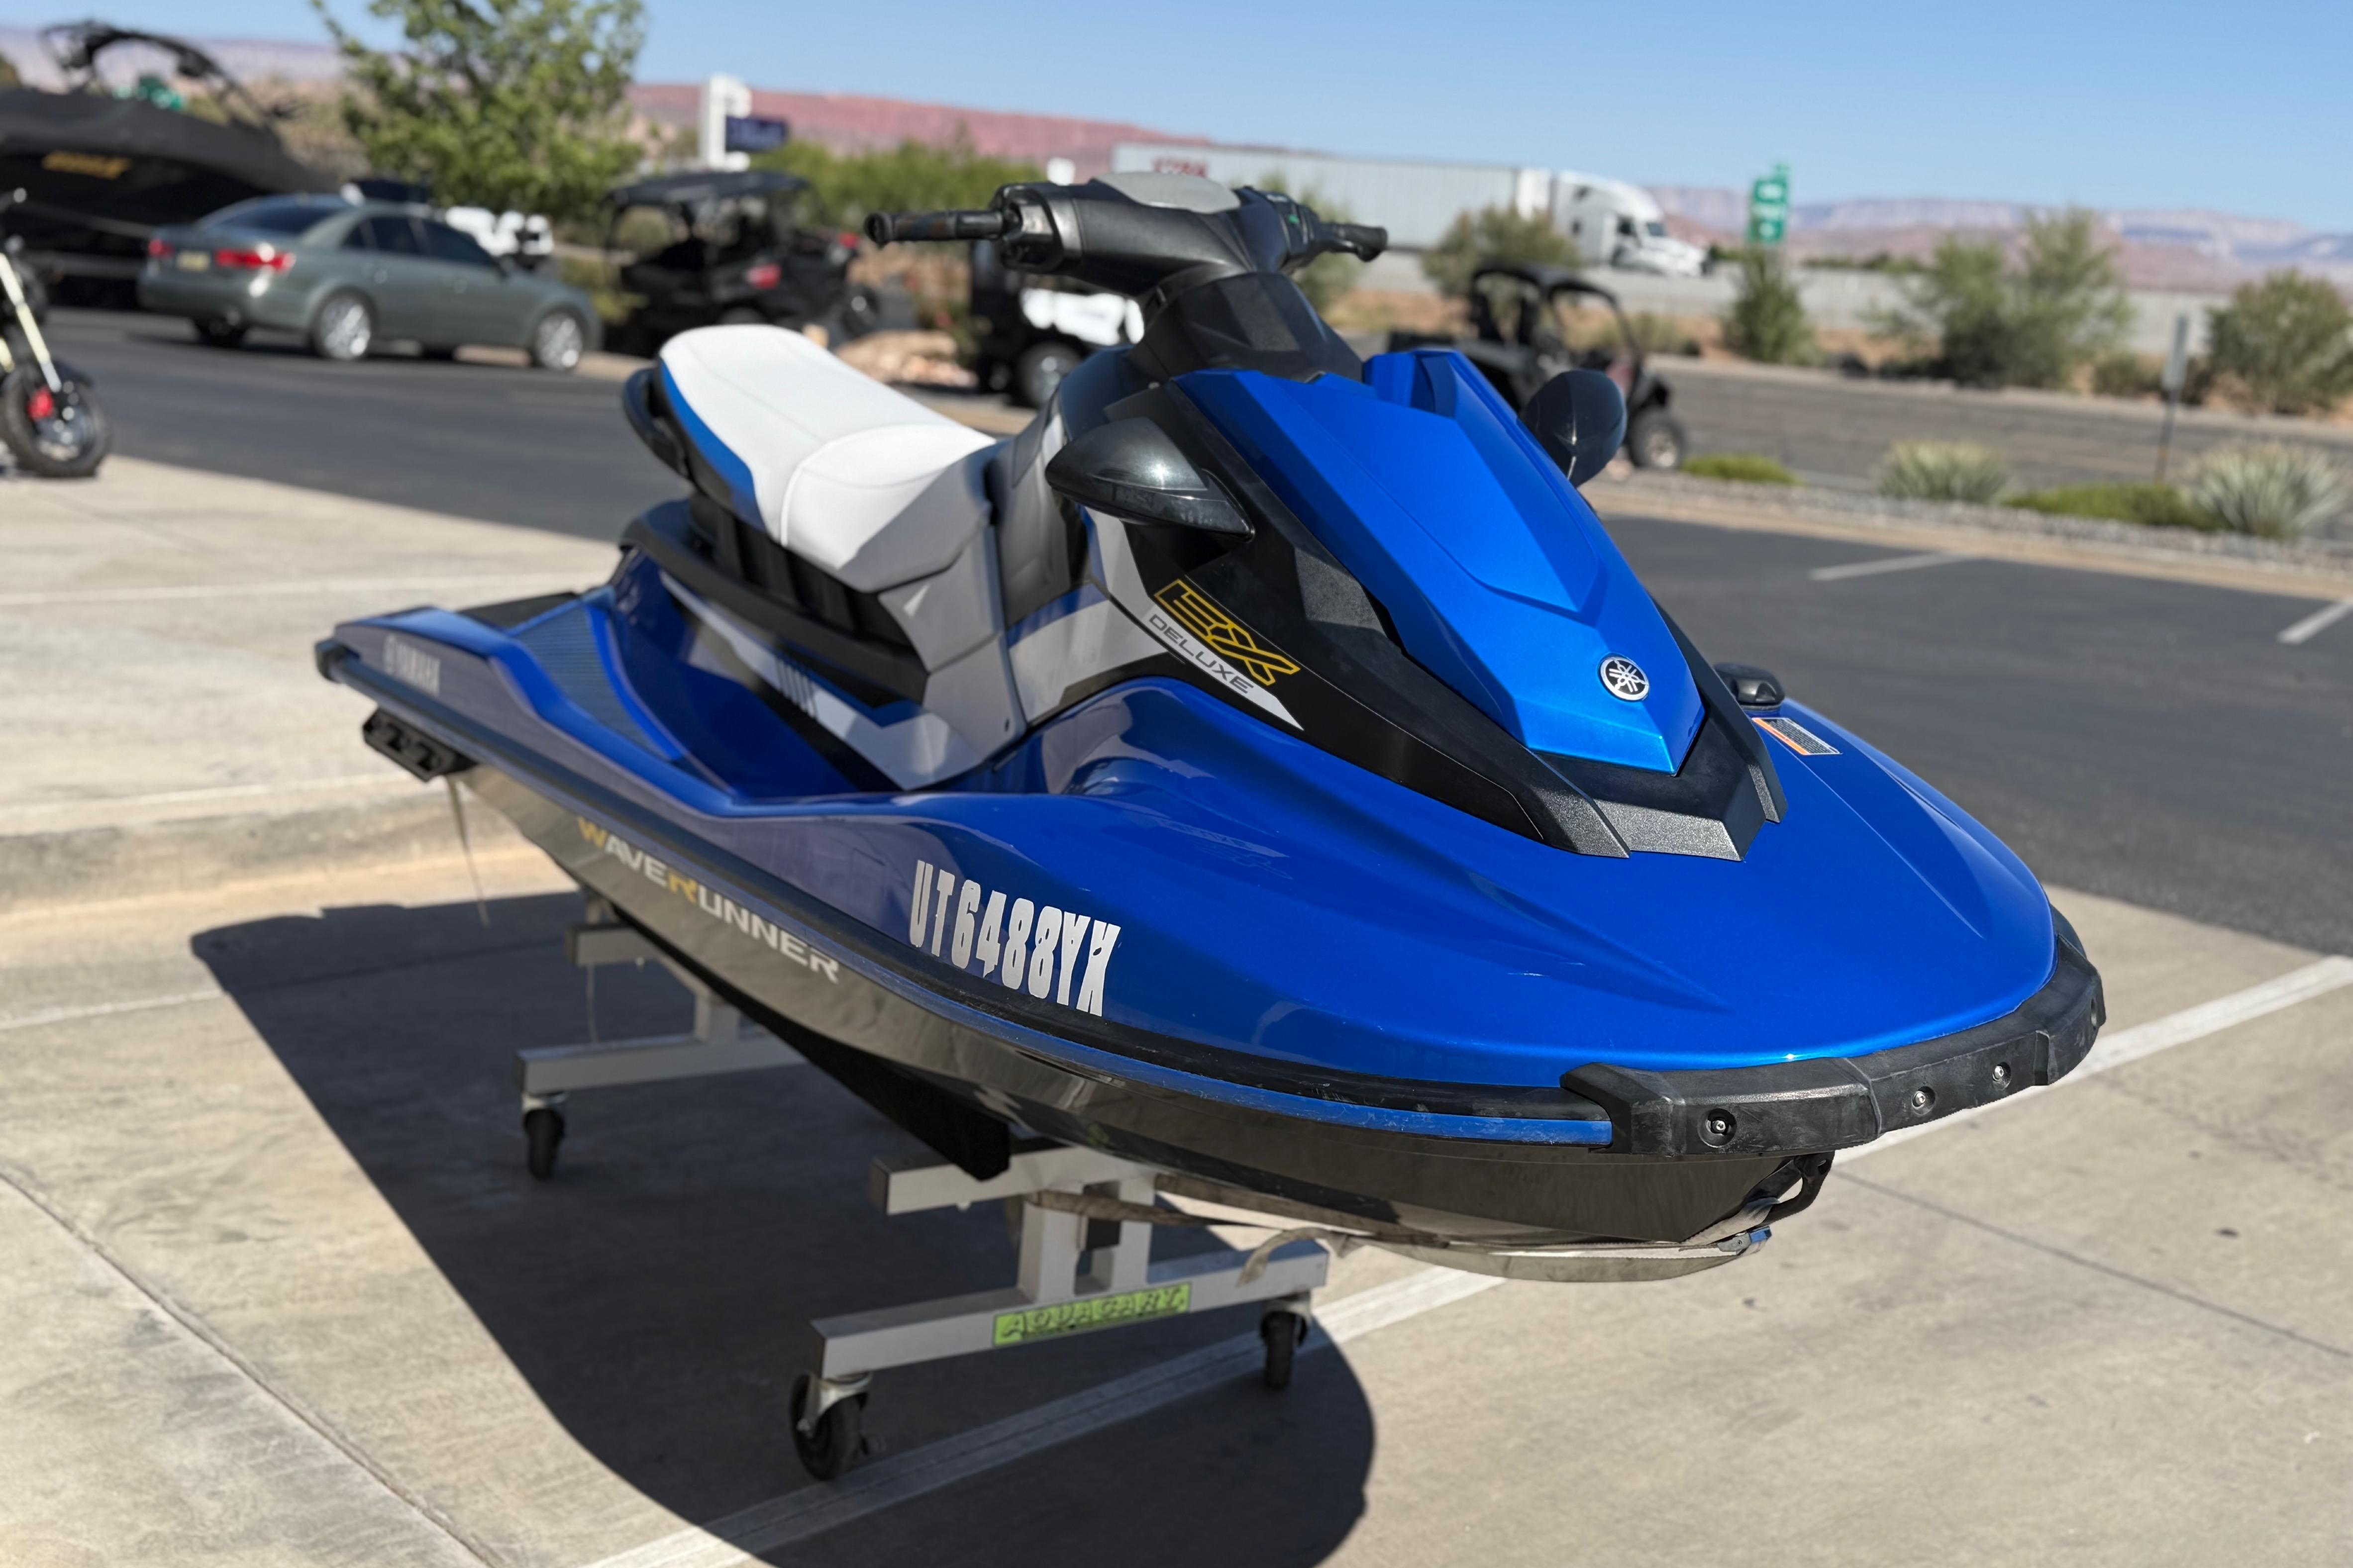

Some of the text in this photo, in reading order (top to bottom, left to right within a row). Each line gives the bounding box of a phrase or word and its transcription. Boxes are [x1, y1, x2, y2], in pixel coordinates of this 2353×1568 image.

[1149, 614, 1254, 693] DELUXE
[1154, 579, 1301, 686] EX
[576, 816, 839, 983] WAVERUNNER
[910, 860, 1121, 1017] UT6488YX
